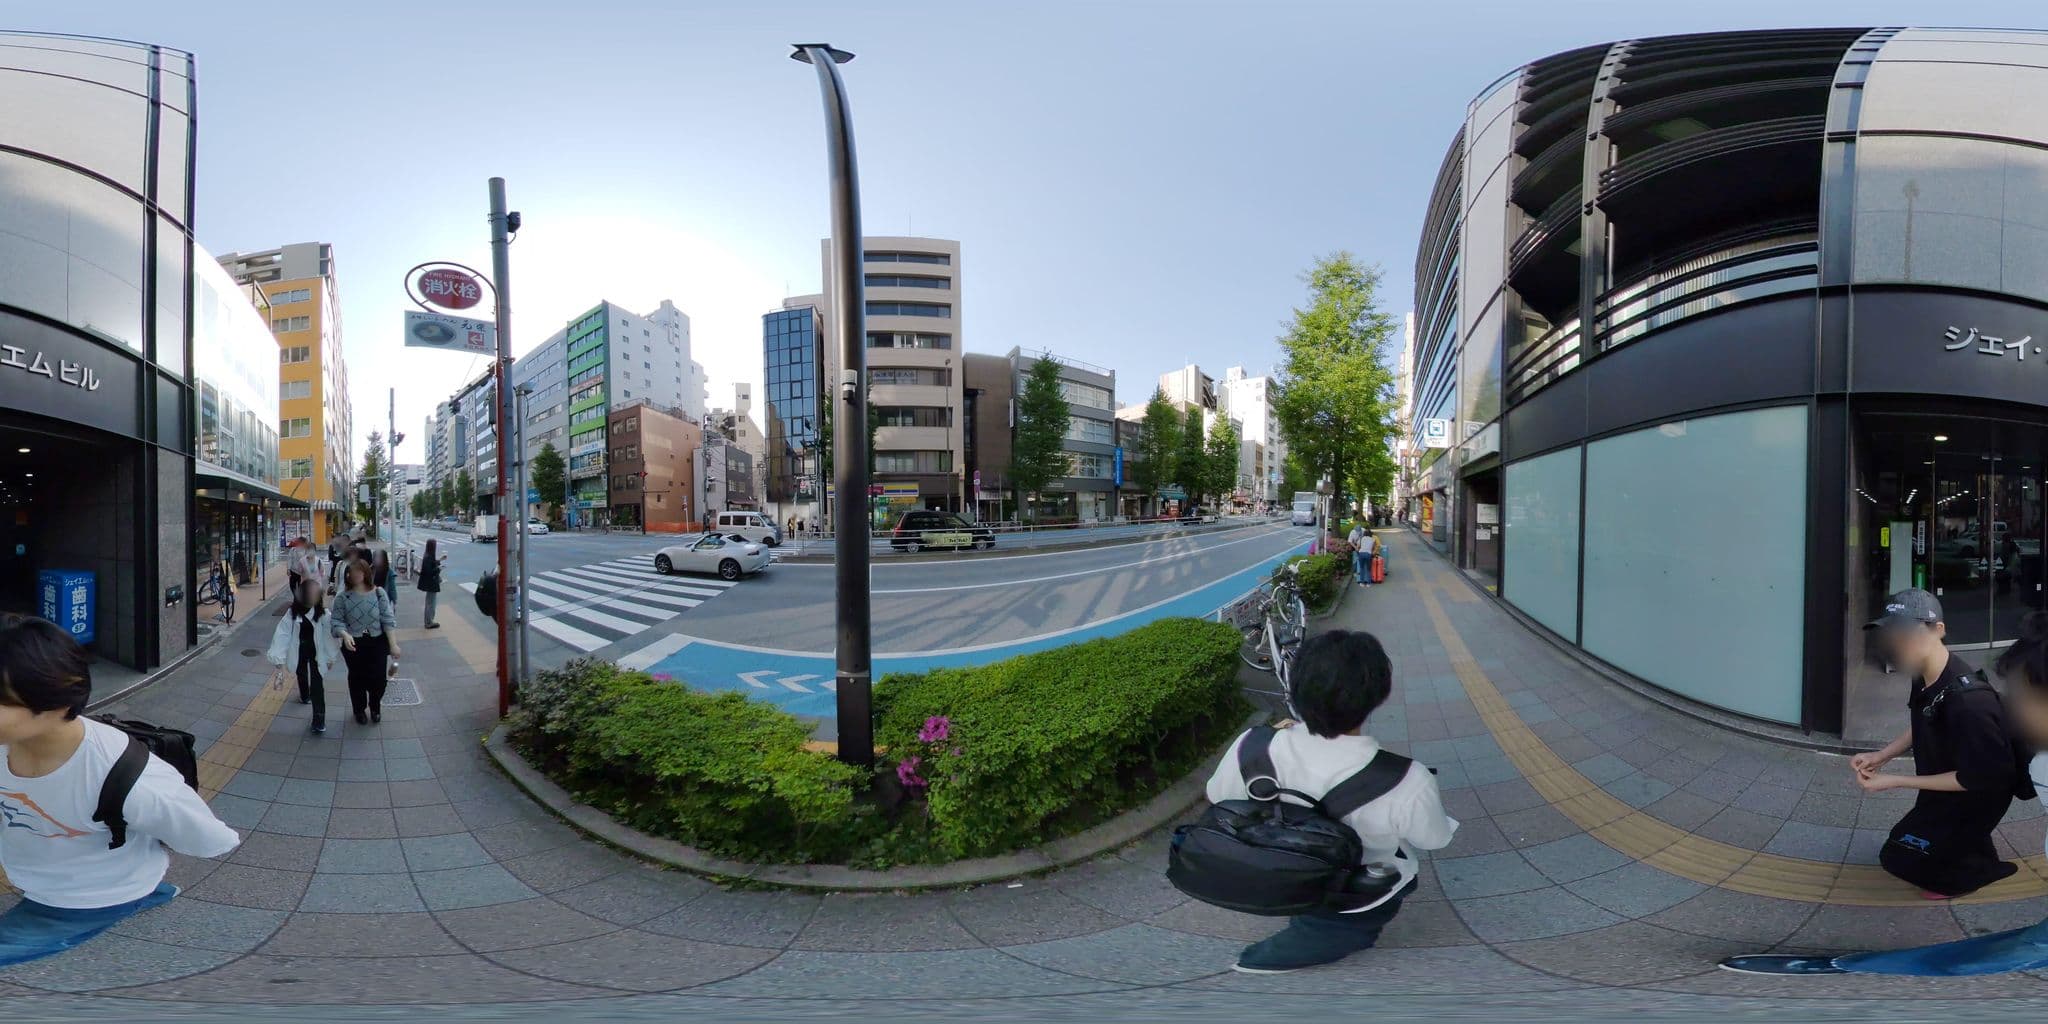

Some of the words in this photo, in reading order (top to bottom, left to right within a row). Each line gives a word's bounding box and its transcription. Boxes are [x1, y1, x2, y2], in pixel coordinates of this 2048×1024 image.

[424, 279, 477, 299] 消火栓
[71, 585, 88, 623] 歯科
